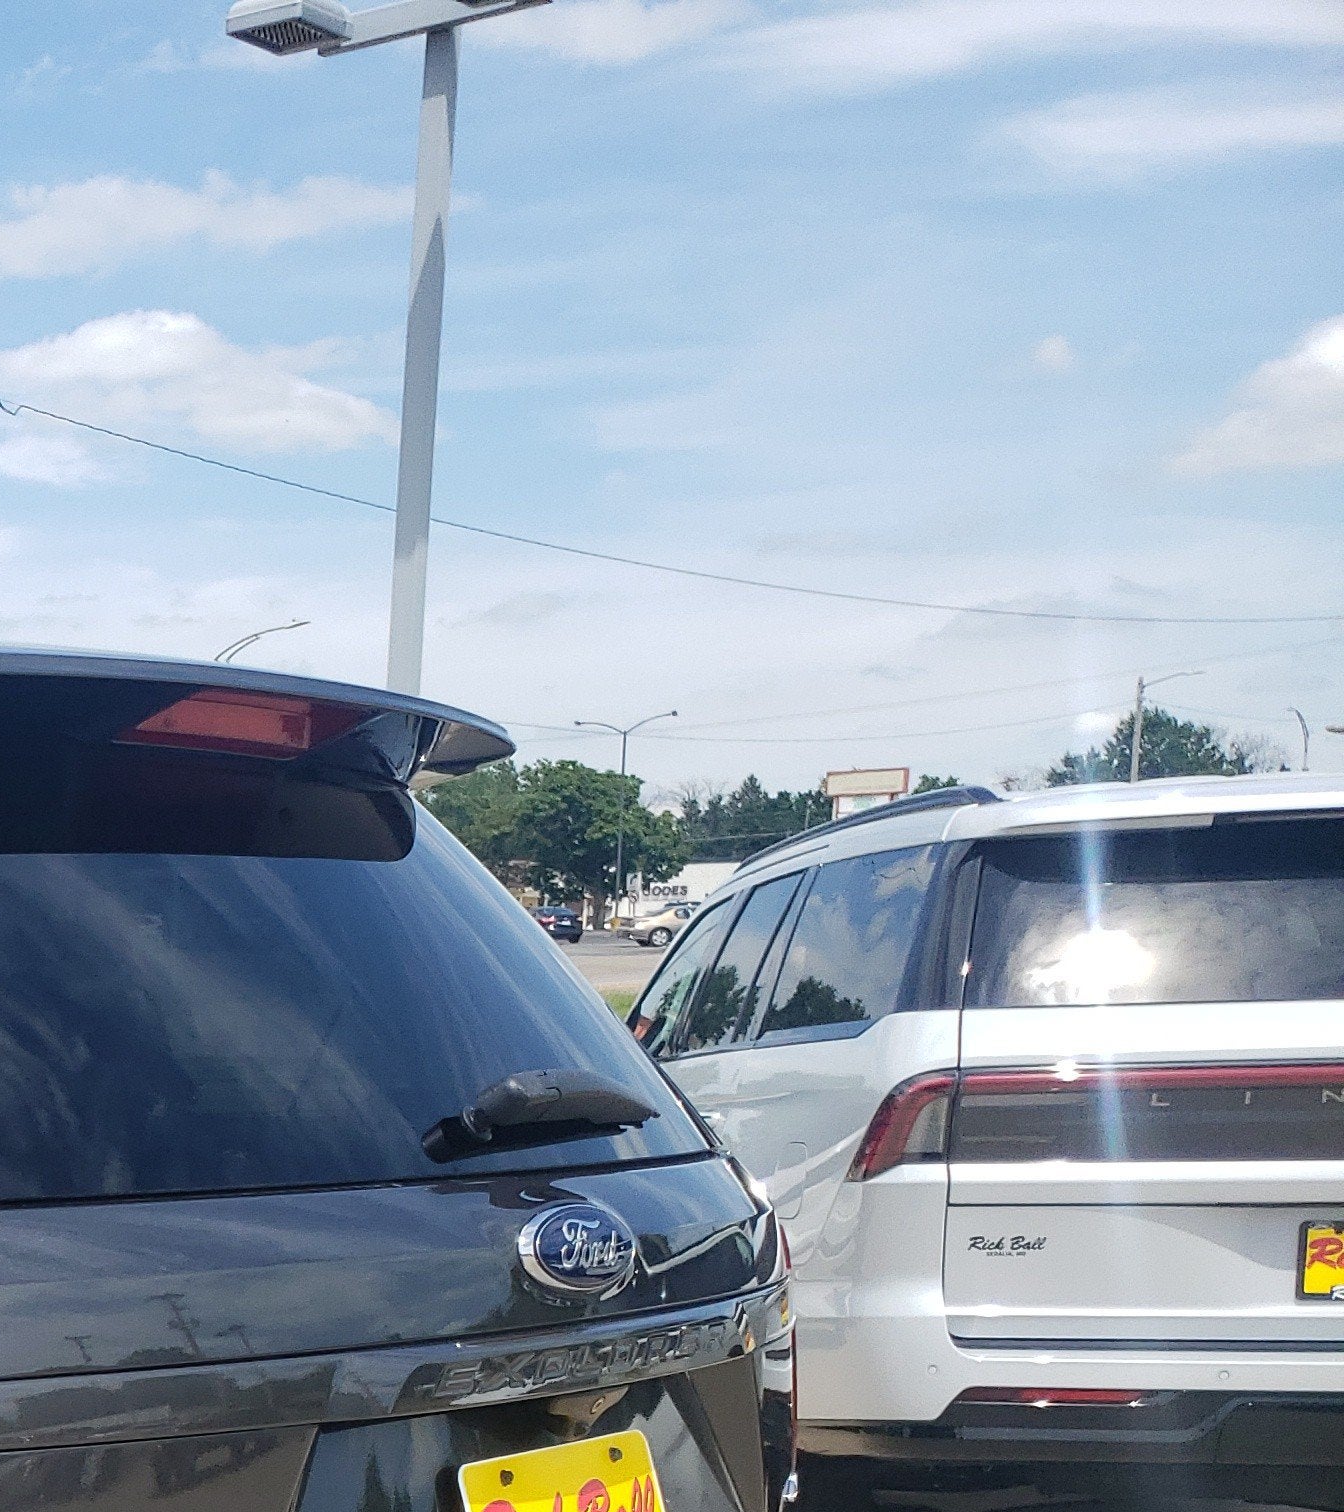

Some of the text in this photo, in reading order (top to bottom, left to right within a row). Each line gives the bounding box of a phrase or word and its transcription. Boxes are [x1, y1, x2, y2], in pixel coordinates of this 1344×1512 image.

[561, 1218, 633, 1270] Ford
[967, 1235, 1047, 1251] Rick Ball
